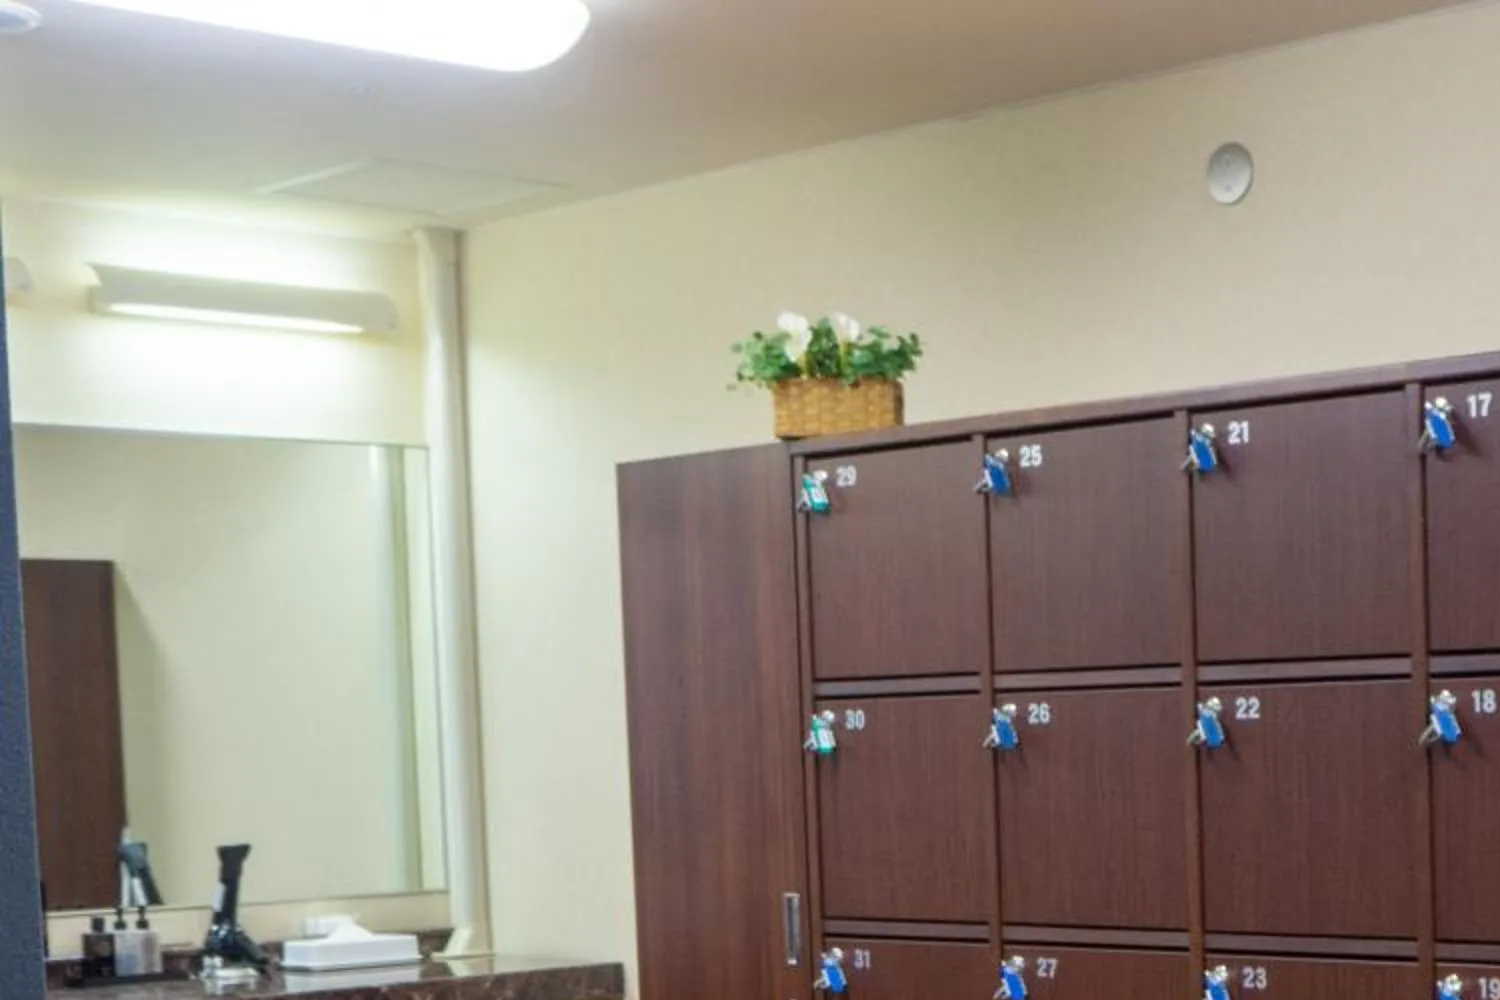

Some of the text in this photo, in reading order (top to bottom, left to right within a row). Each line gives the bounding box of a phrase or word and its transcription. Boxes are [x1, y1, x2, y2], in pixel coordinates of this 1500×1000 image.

[1466, 391, 1493, 418] 17
[1227, 420, 1250, 445] 21
[1018, 443, 1043, 468] 25
[835, 464, 857, 487] 29
[1027, 702, 1051, 724] 26
[1235, 695, 1261, 720] 22
[1471, 688, 1497, 714] 18
[844, 708, 866, 731] 30
[853, 948, 871, 969] 31
[1035, 956, 1058, 979] 27
[1242, 965, 1268, 990] 23
